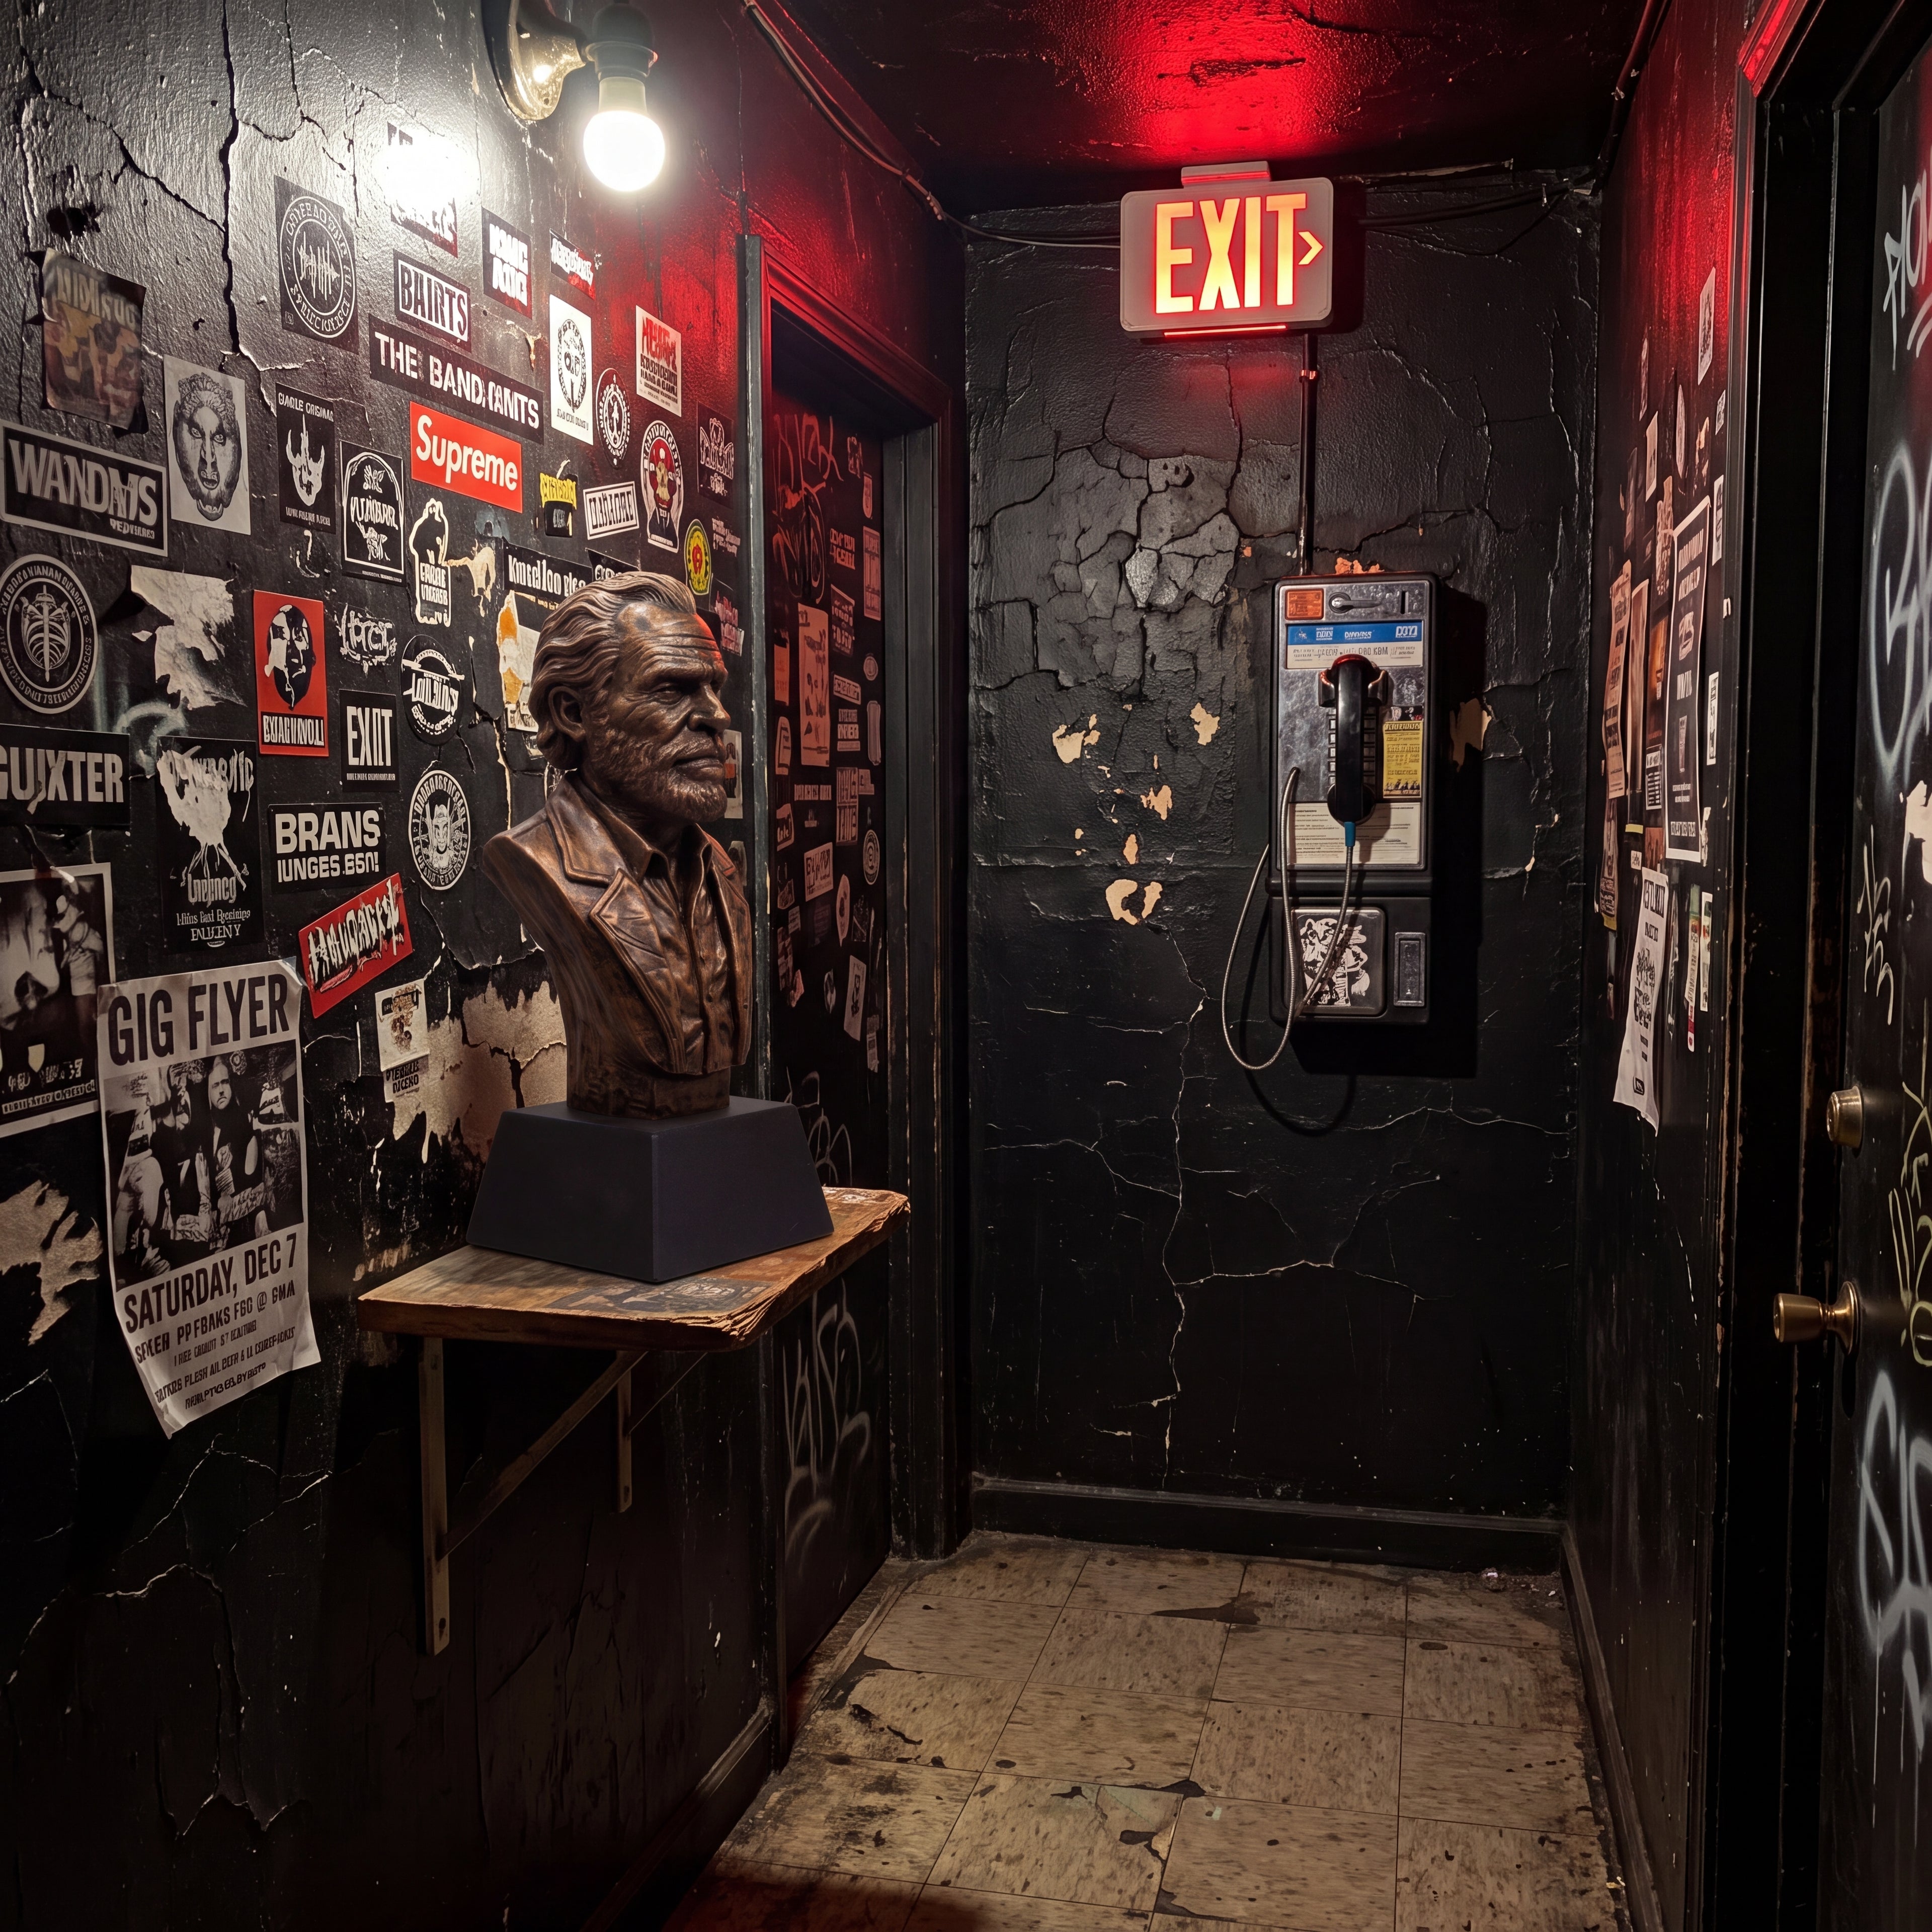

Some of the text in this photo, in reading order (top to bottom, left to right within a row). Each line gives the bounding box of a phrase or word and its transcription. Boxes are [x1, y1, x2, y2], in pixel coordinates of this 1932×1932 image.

[1155, 192, 1307, 314] EXIT
[375, 331, 418, 379] THE
[416, 414, 518, 491] Supreme
[275, 810, 381, 854] BRANS
[108, 973, 290, 1067] GIG FLYER
[124, 1232, 297, 1334] SATURDAY, DEC 7
